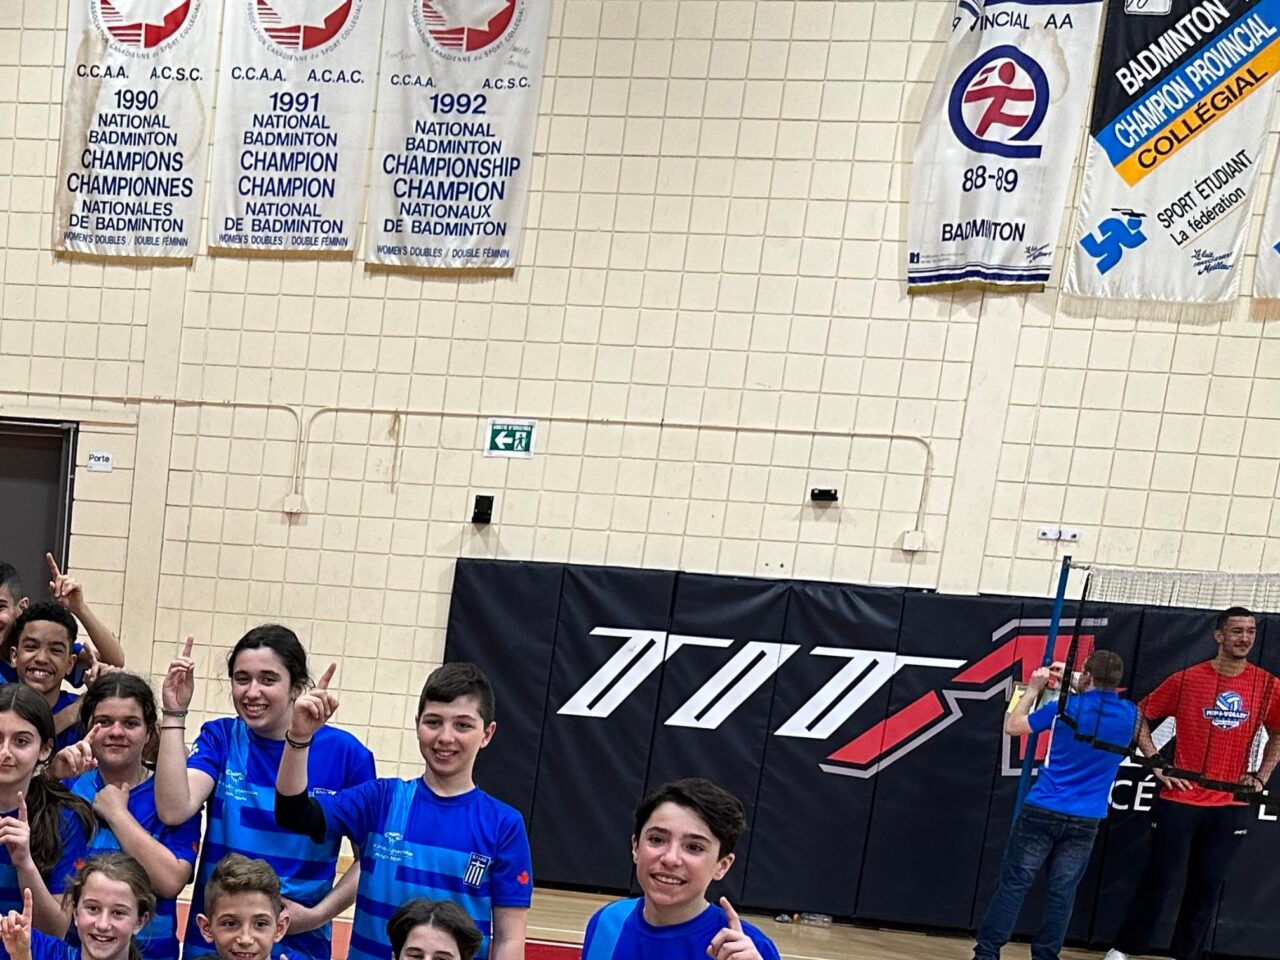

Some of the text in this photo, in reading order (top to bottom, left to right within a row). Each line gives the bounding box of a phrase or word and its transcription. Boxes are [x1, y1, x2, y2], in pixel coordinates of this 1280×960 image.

[1044, 14, 1074, 30] AA
[1115, 0, 1230, 96] BADMINTON
[77, 64, 203, 81] C.C.A.A. A.C.S.C.
[231, 66, 365, 84] C.C.A.A. A.C.A.C.
[1114, 14, 1277, 149] CHAMPION PROVINCIAL
[390, 74, 531, 90] C.C.A.A. A.C.S.C.
[114, 89, 159, 110] 1990
[269, 92, 320, 112] 1991
[430, 93, 487, 115] 1992
[98, 113, 171, 129] NATIONAL
[253, 114, 330, 129] NATIONAL
[415, 120, 496, 137] NATIONAL
[1137, 69, 1269, 170] COLLÉGIAL
[89, 130, 178, 146] BADMINTON
[244, 131, 338, 147] BADMINTON
[406, 137, 502, 155] BADMINTON
[81, 149, 184, 172] CHAMPIONS
[240, 150, 338, 172] CHAMPION
[383, 154, 521, 178] CHAMPIONSHIP
[67, 173, 194, 197] CHAMPIONNES
[238, 175, 335, 198] CHAMPION
[962, 165, 1018, 193] 88-89
[393, 178, 505, 201] CHAMPION
[1157, 149, 1253, 229] SPORT ÉTUDIANT
[82, 200, 173, 216] NATIONALES
[245, 202, 322, 217] NATIONAL
[399, 202, 492, 219] NATIONAUX
[1170, 187, 1246, 246] La fédération
[69, 214, 184, 233] DE BADMINTON
[224, 217, 343, 234] DE BADMINTON
[384, 219, 507, 237] DE BADMINTON
[942, 219, 1026, 242] BADMINTON
[95, 234, 126, 246] DOUBLES
[134, 236, 160, 246] DOUBLE
[251, 235, 283, 246] DOUBLES
[291, 236, 319, 246] DOUBLE
[410, 246, 442, 258] DOUBLES
[452, 248, 480, 258] DOUBLE
[89, 453, 110, 462] Porte
